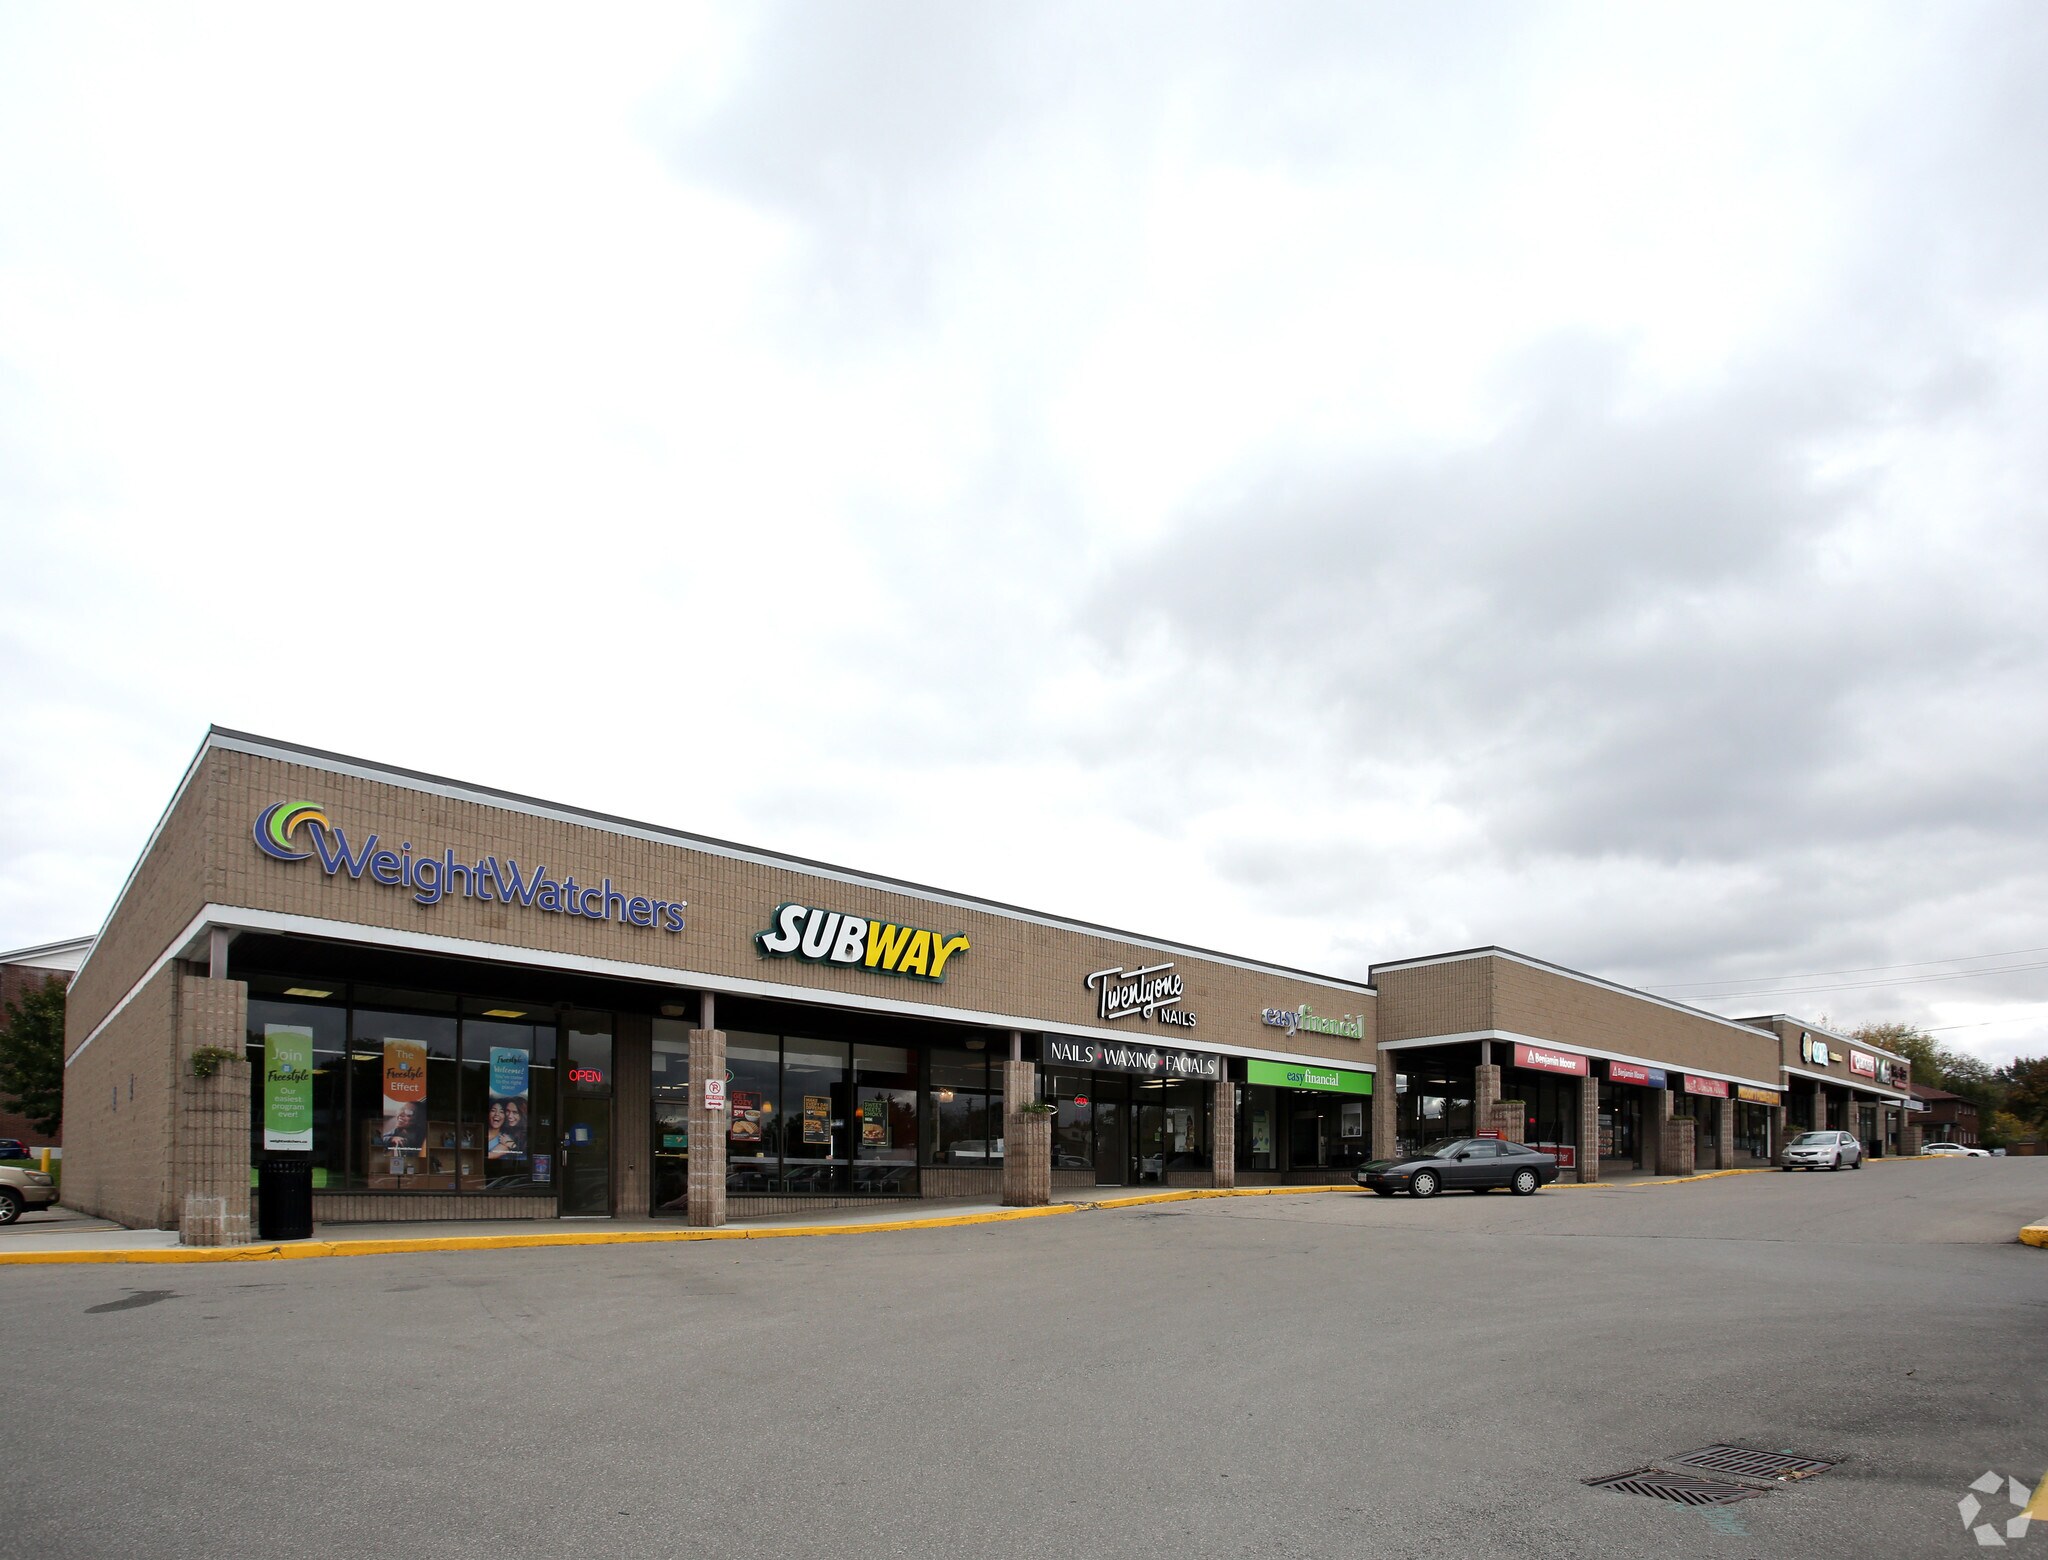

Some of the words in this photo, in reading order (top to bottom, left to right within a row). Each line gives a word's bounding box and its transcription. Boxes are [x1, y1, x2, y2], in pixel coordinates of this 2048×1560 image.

[308, 822, 685, 932] WeightWatchers
[762, 904, 971, 977] SUBWAY
[1087, 963, 1183, 1019] Twentyone
[1161, 1008, 1196, 1027] NAILS
[1263, 1004, 1365, 1037] easyfinancial
[272, 1048, 303, 1061] Join
[396, 1049, 414, 1059] The
[1051, 1042, 1094, 1063] NAILS
[1104, 1048, 1157, 1069] WAXING
[1165, 1055, 1215, 1075] FACIALS
[1535, 1052, 1559, 1066] Benjamin
[1560, 1057, 1576, 1069] Moore
[268, 1069, 309, 1083] Freestyle
[386, 1067, 423, 1080] Freestyle
[569, 1069, 602, 1082] OPEN
[1287, 1069, 1339, 1086] easyfinancial
[280, 1087, 296, 1095] Our
[391, 1082, 419, 1092] Effect
[274, 1095, 303, 1103] easiest
[272, 1103, 304, 1111] program
[278, 1110, 298, 1118] ever!
